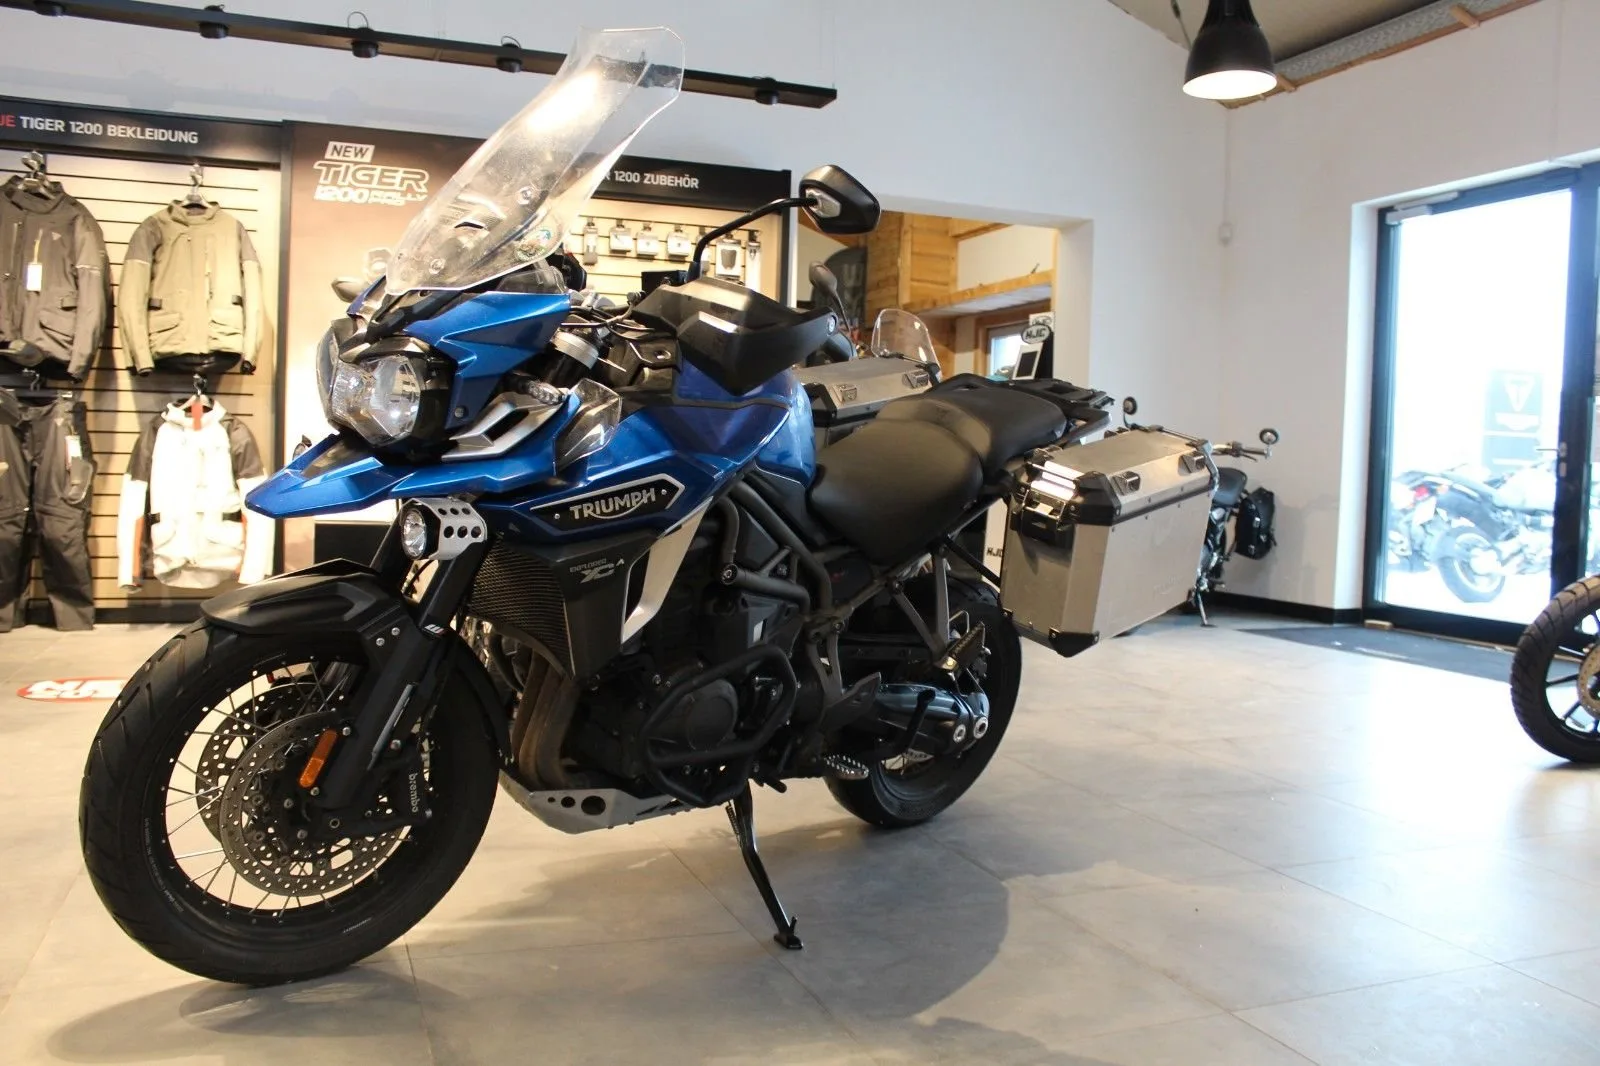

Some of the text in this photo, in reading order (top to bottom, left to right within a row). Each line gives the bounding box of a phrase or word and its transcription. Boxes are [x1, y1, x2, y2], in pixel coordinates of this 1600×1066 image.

[20, 115, 65, 132] TIGER
[70, 121, 103, 136] 1200
[107, 125, 198, 144] BEKLEIDUNG
[330, 144, 369, 159] NEW
[313, 160, 429, 193] TIGER
[614, 170, 641, 183] 1200
[643, 173, 699, 189] ZUBEHÖR
[570, 488, 655, 519] TRIUMPH
[408, 773, 420, 813] brembo
